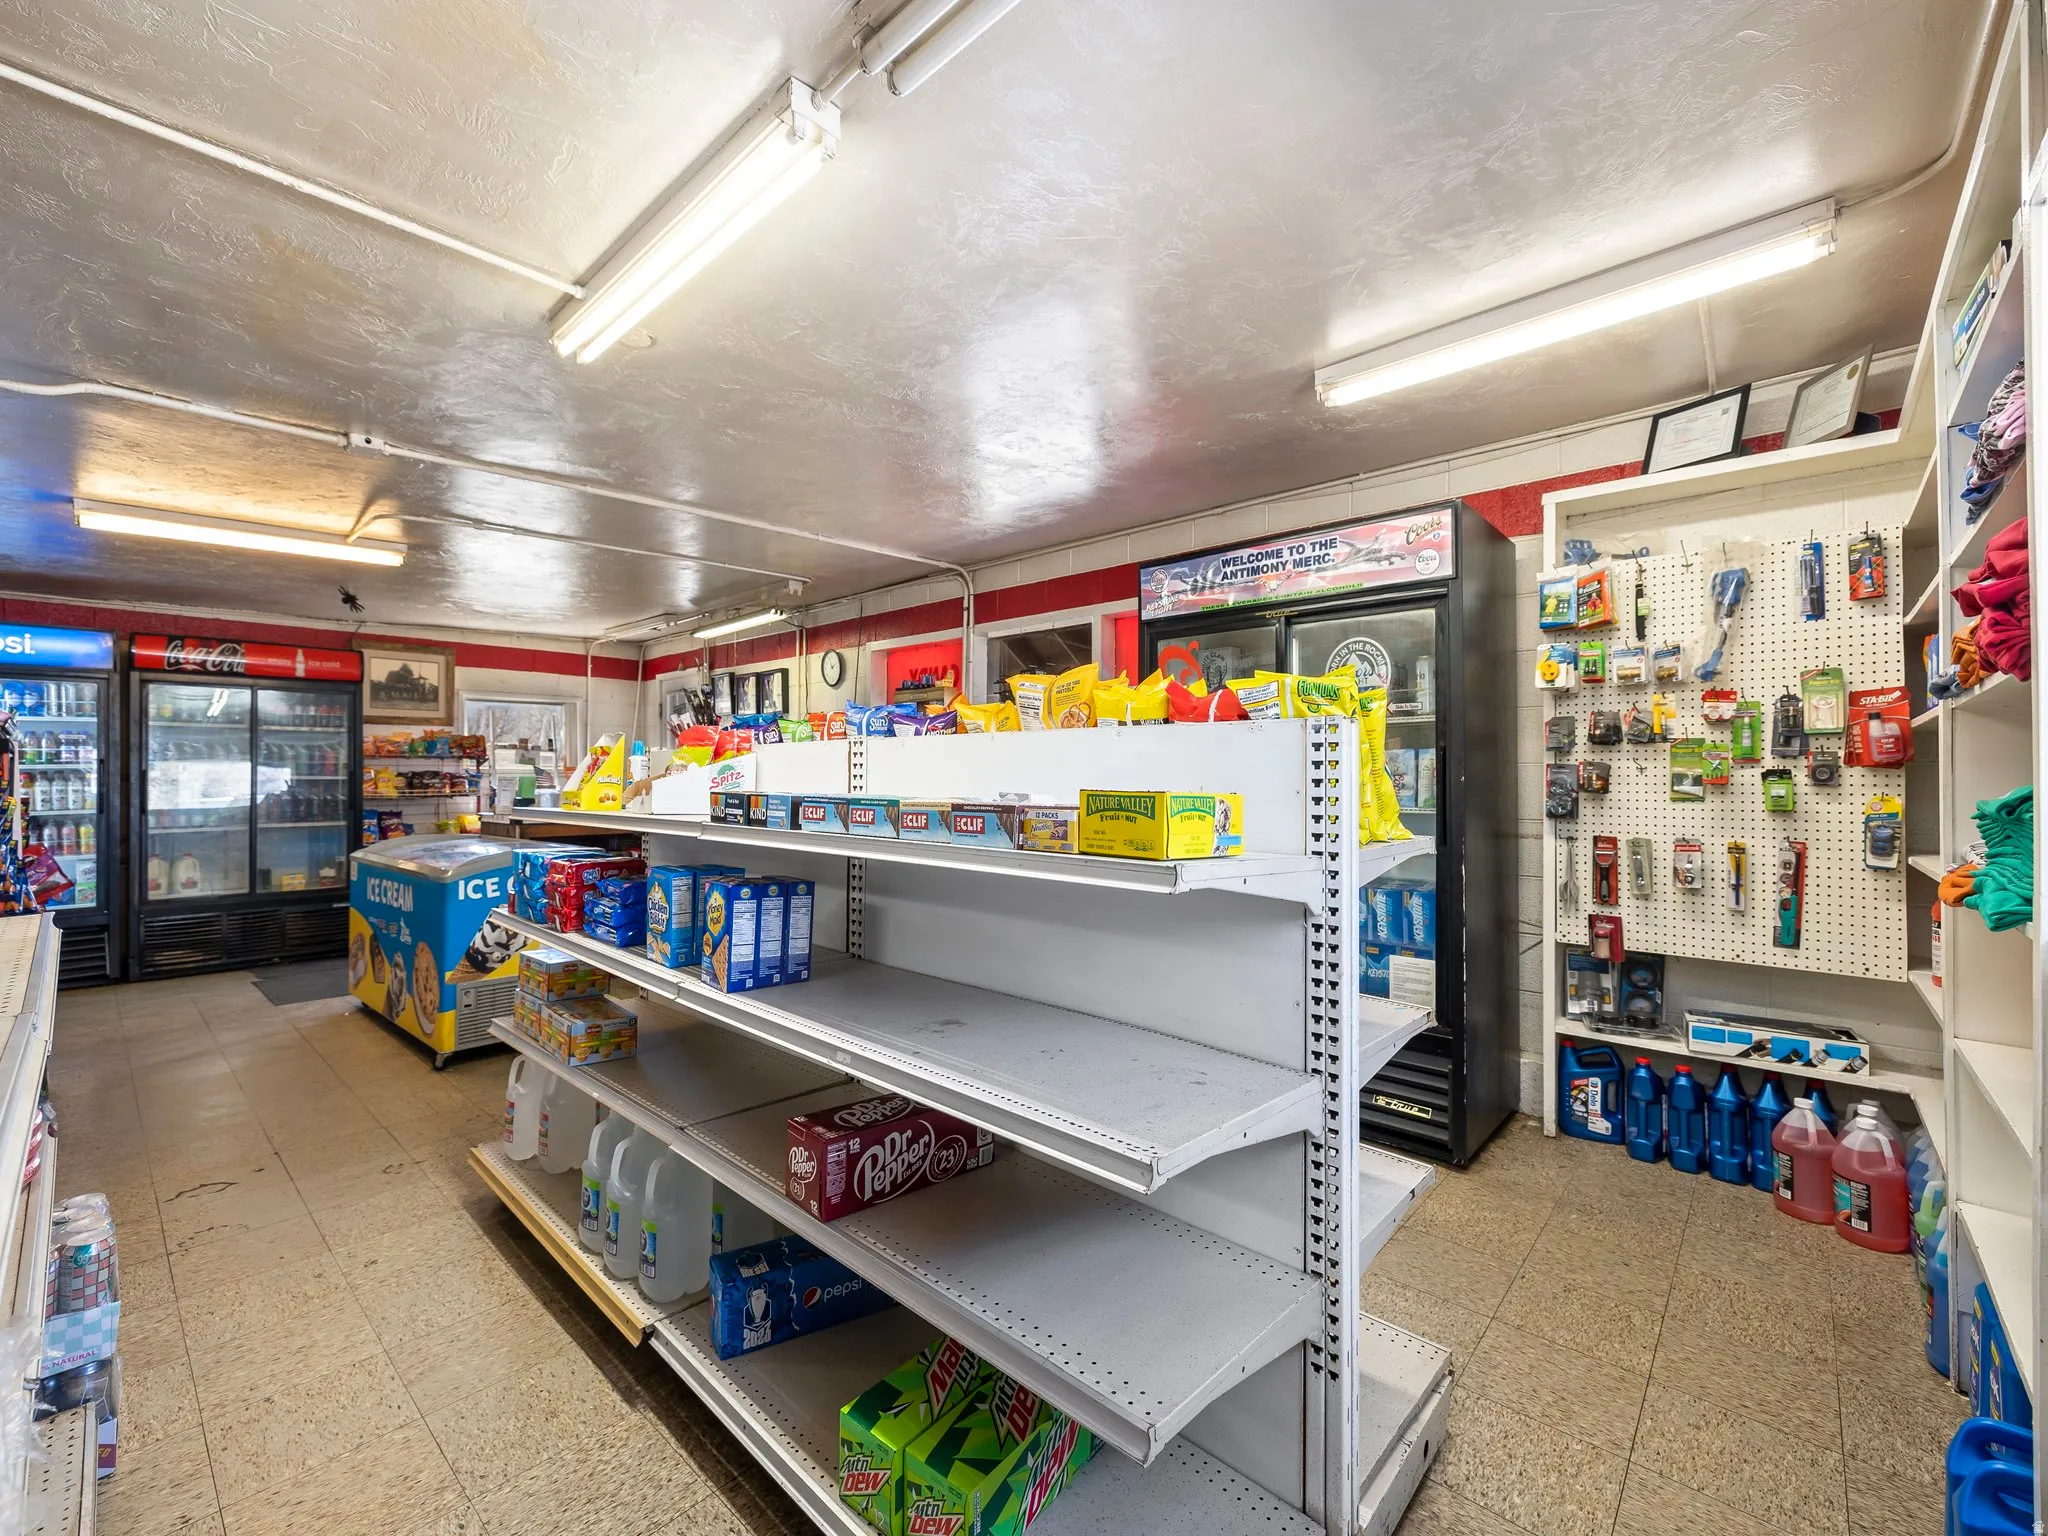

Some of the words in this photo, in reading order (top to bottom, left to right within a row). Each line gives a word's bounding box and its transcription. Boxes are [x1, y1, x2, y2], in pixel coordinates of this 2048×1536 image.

[1404, 516, 1442, 545] Coors
[1220, 547, 1284, 569] WELCOME
[1287, 543, 1306, 557] TO
[1309, 537, 1338, 553] THE
[1220, 559, 1289, 582] ANTIMONY
[1292, 552, 1336, 570] MERC.
[1145, 593, 1181, 612] KEYSTONE
[1151, 603, 1174, 617] LIGHT
[1201, 603, 1225, 611] THESE
[1275, 590, 1313, 599] CONTAIN
[164, 639, 246, 673] Coca-Cola
[1339, 647, 1349, 657] IN
[1348, 642, 1364, 652] THE
[709, 769, 745, 790] Spitz
[710, 806, 726, 817] KIND
[749, 807, 767, 820] KIND
[808, 806, 825, 819] CLIF
[855, 809, 874, 823] CLIF
[1035, 811, 1041, 819] 12
[1088, 795, 1120, 816] NATURE
[1119, 795, 1155, 818] VALLEY
[1170, 796, 1195, 816] NATURE
[1194, 796, 1215, 816] VALLEY
[906, 814, 927, 828] CLIF
[960, 816, 983, 832] CLIF
[1099, 812, 1121, 823] Fruit
[1124, 814, 1138, 825] NUT
[366, 876, 380, 904] ICE
[381, 879, 414, 912] CREAM
[458, 877, 501, 901] ICE
[647, 896, 669, 917] Chicken
[708, 899, 724, 914] Honey
[1377, 893, 1388, 939] KEYSTONE
[709, 914, 721, 927] Maid
[1412, 896, 1424, 943] KEYSTONE
[1367, 968, 1389, 979] KEYSTO
[852, 1099, 881, 1114] Dr
[1590, 1090, 1599, 1107] Delo
[840, 1097, 903, 1127] Pepper
[848, 1137, 861, 1150] 12
[884, 1129, 913, 1166] Dr
[791, 1147, 816, 1177] Pepper
[798, 1146, 809, 1163] Dr
[939, 1148, 955, 1171] 23
[864, 1134, 930, 1202] Pepper
[810, 1199, 818, 1213] 12
[823, 1278, 862, 1303] pepsi
[52, 1349, 97, 1370] NATURAL
